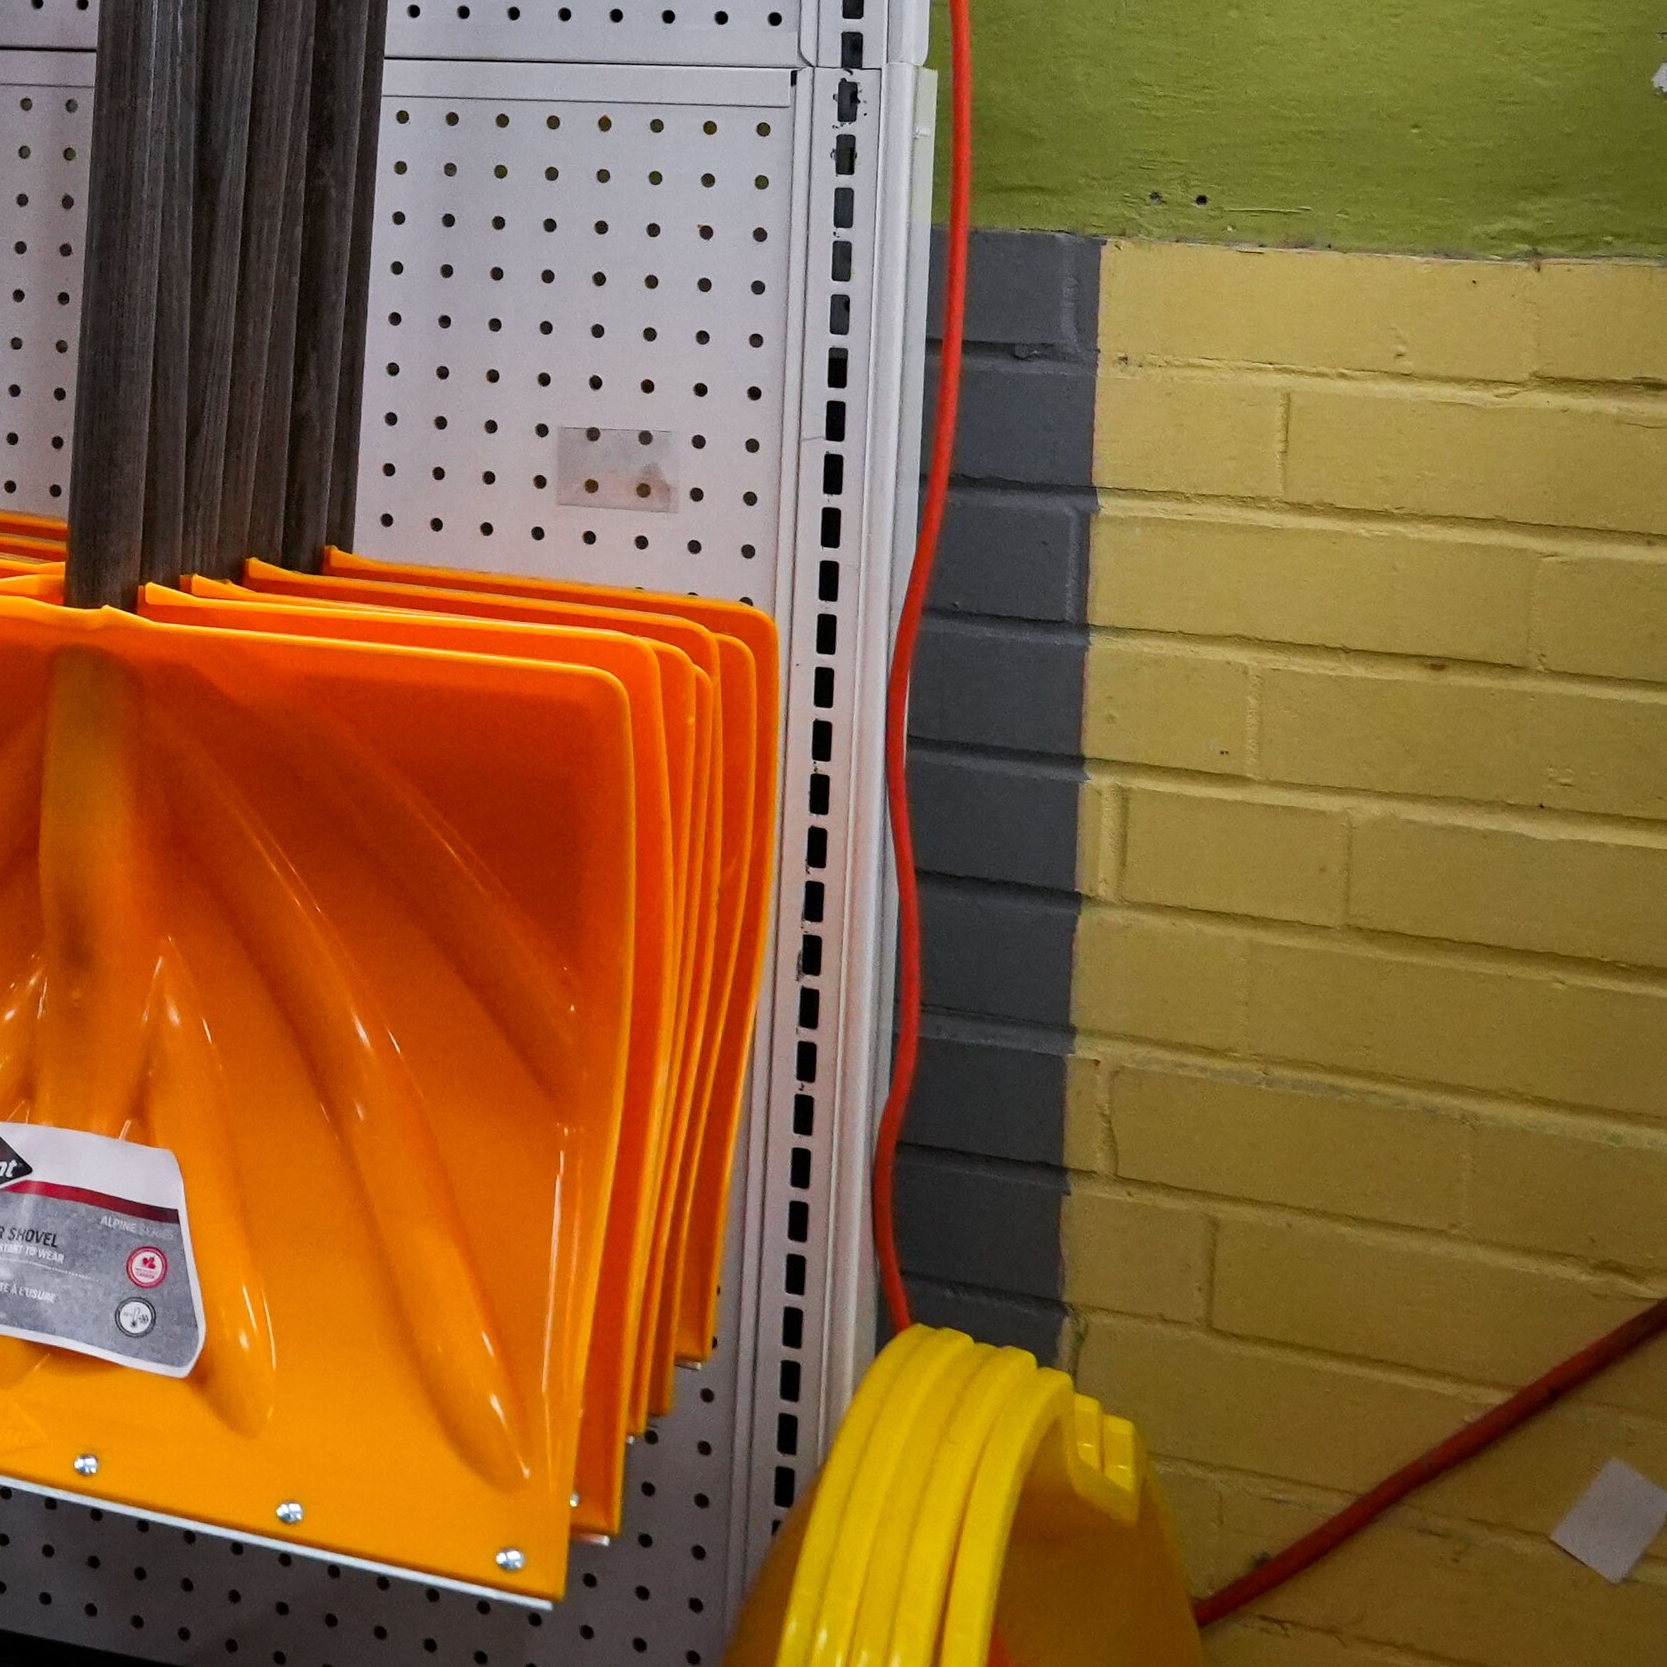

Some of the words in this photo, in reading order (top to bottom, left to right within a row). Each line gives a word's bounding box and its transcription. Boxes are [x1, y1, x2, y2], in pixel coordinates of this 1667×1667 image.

[99, 1214, 138, 1235] ALPINE
[7, 1226, 60, 1248] SHOVEL
[23, 1246, 37, 1256] TO
[36, 1248, 65, 1263] WEAR
